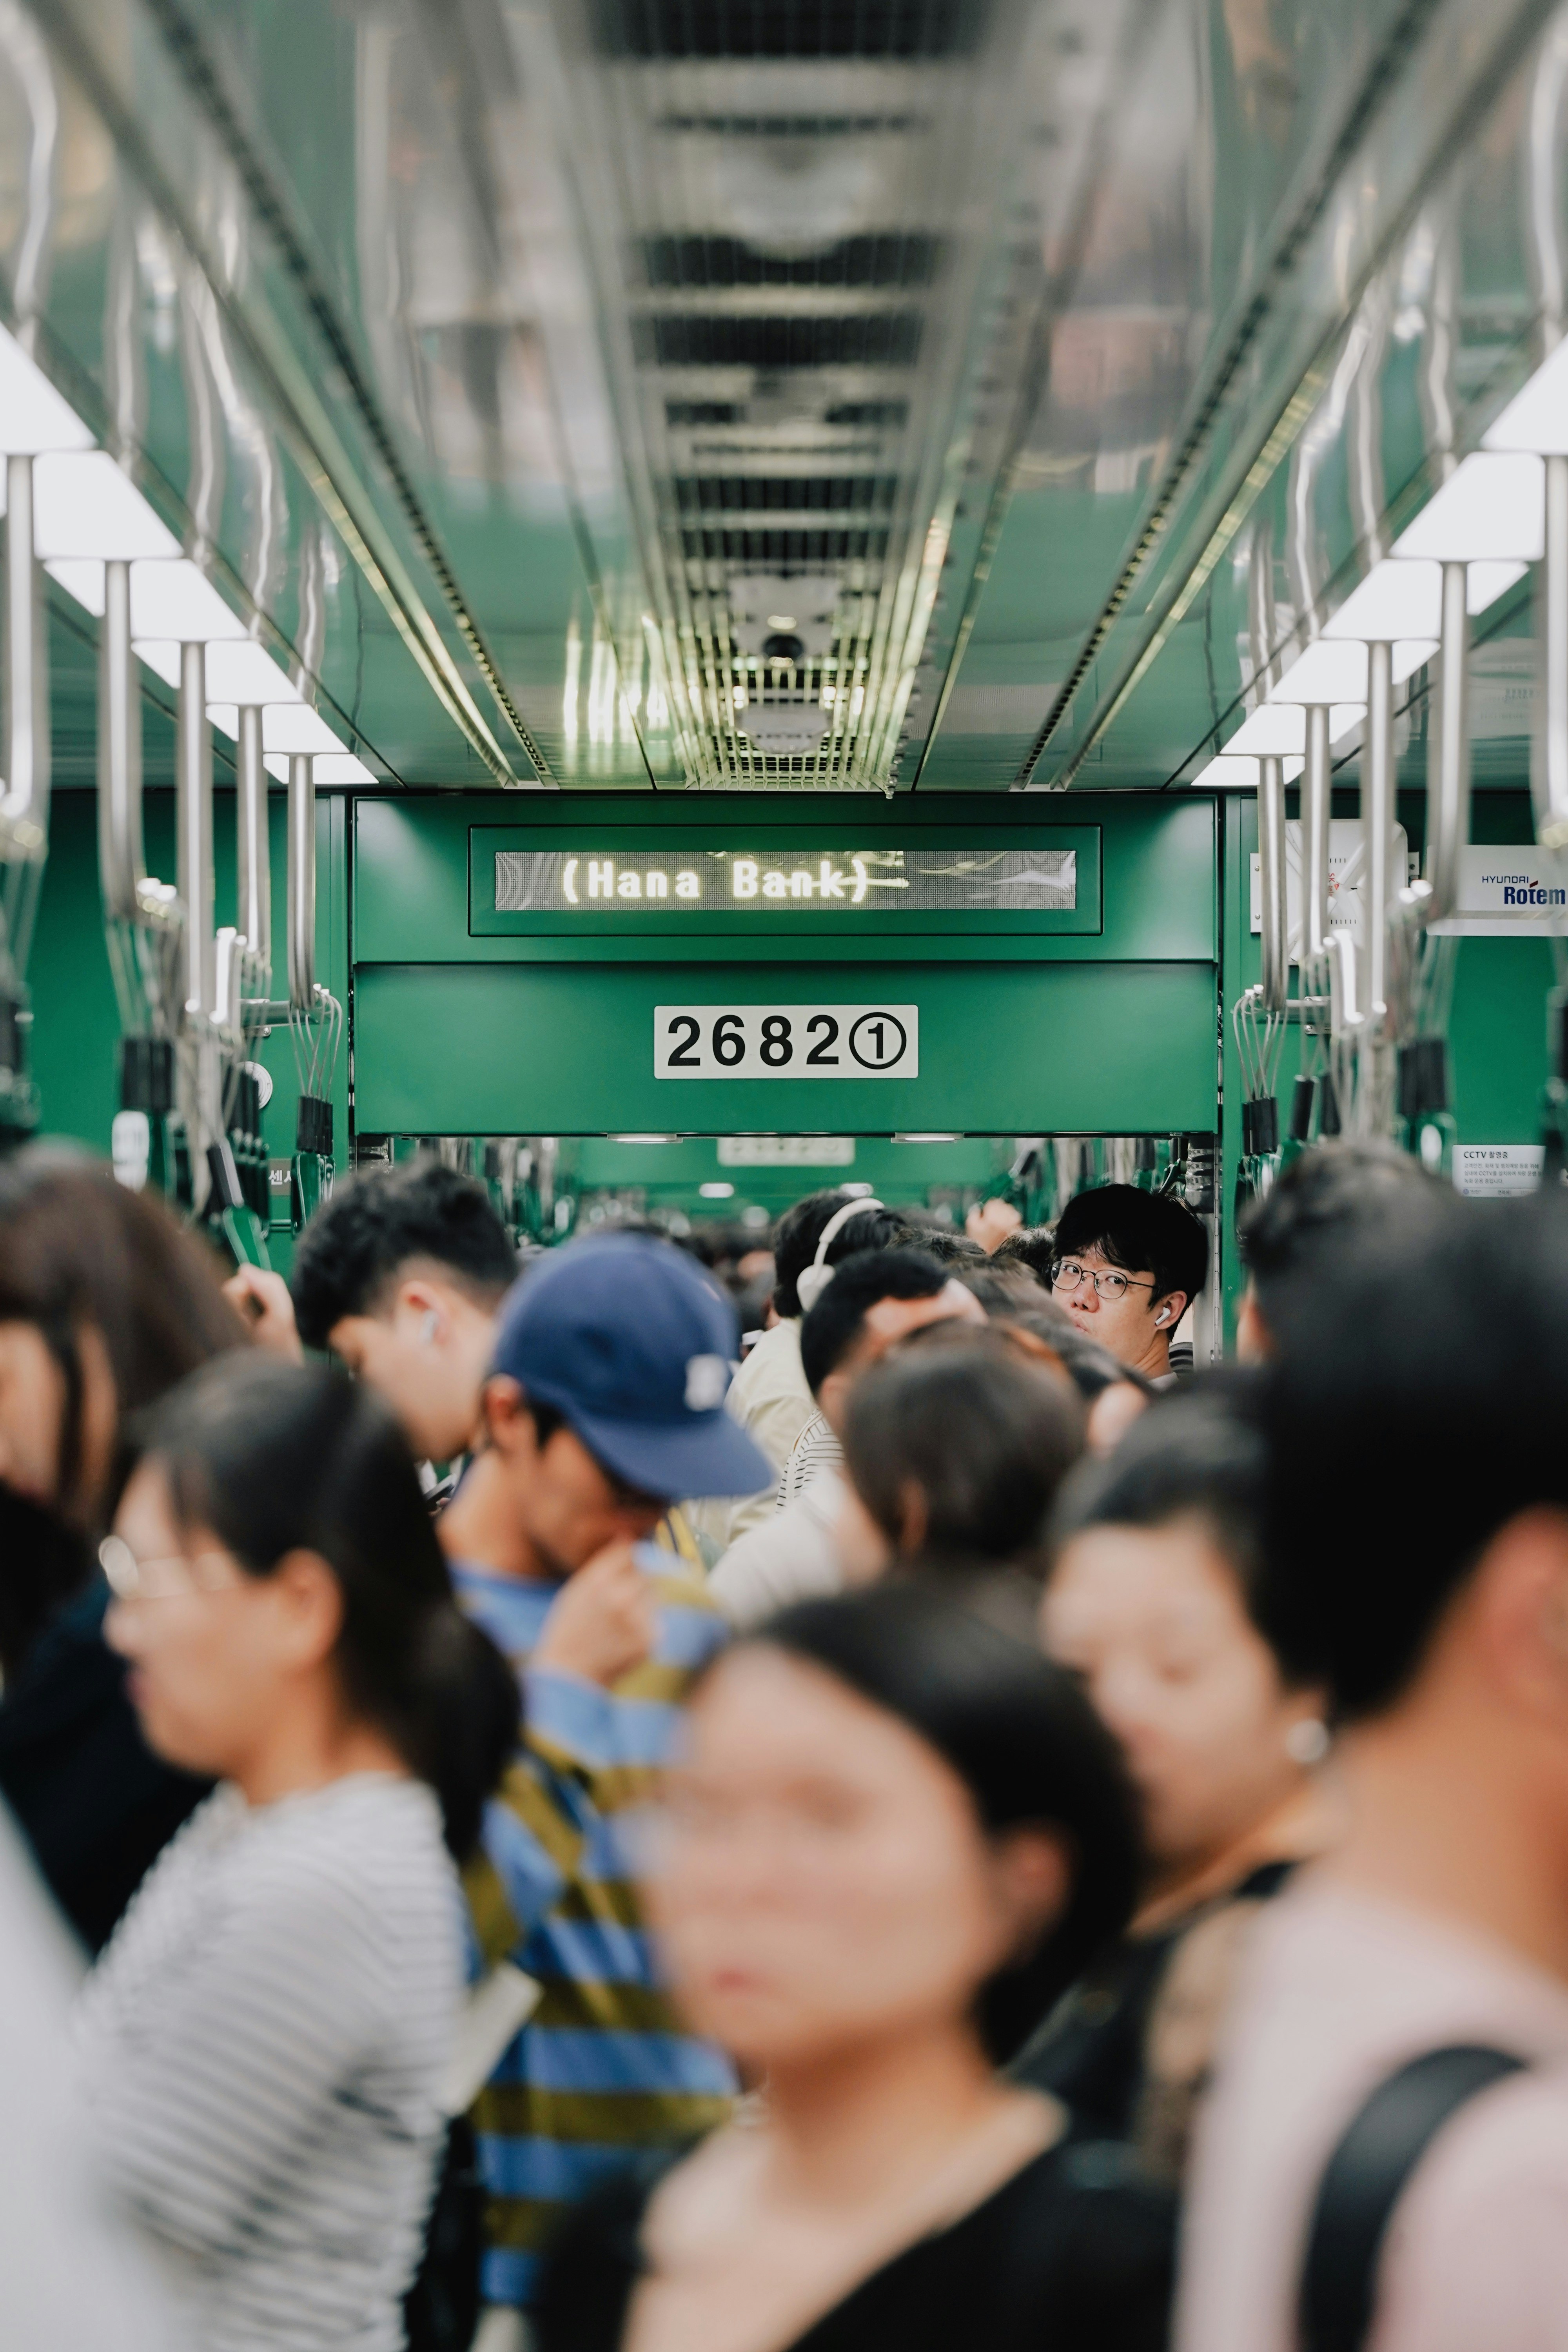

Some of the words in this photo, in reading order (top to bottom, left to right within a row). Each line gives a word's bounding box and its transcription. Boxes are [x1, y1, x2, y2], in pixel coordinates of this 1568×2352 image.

[563, 859, 700, 903] (Hana
[733, 858, 866, 902] Bank)
[1328, 873, 1335, 882] SK
[1504, 880, 1565, 905] Rotem
